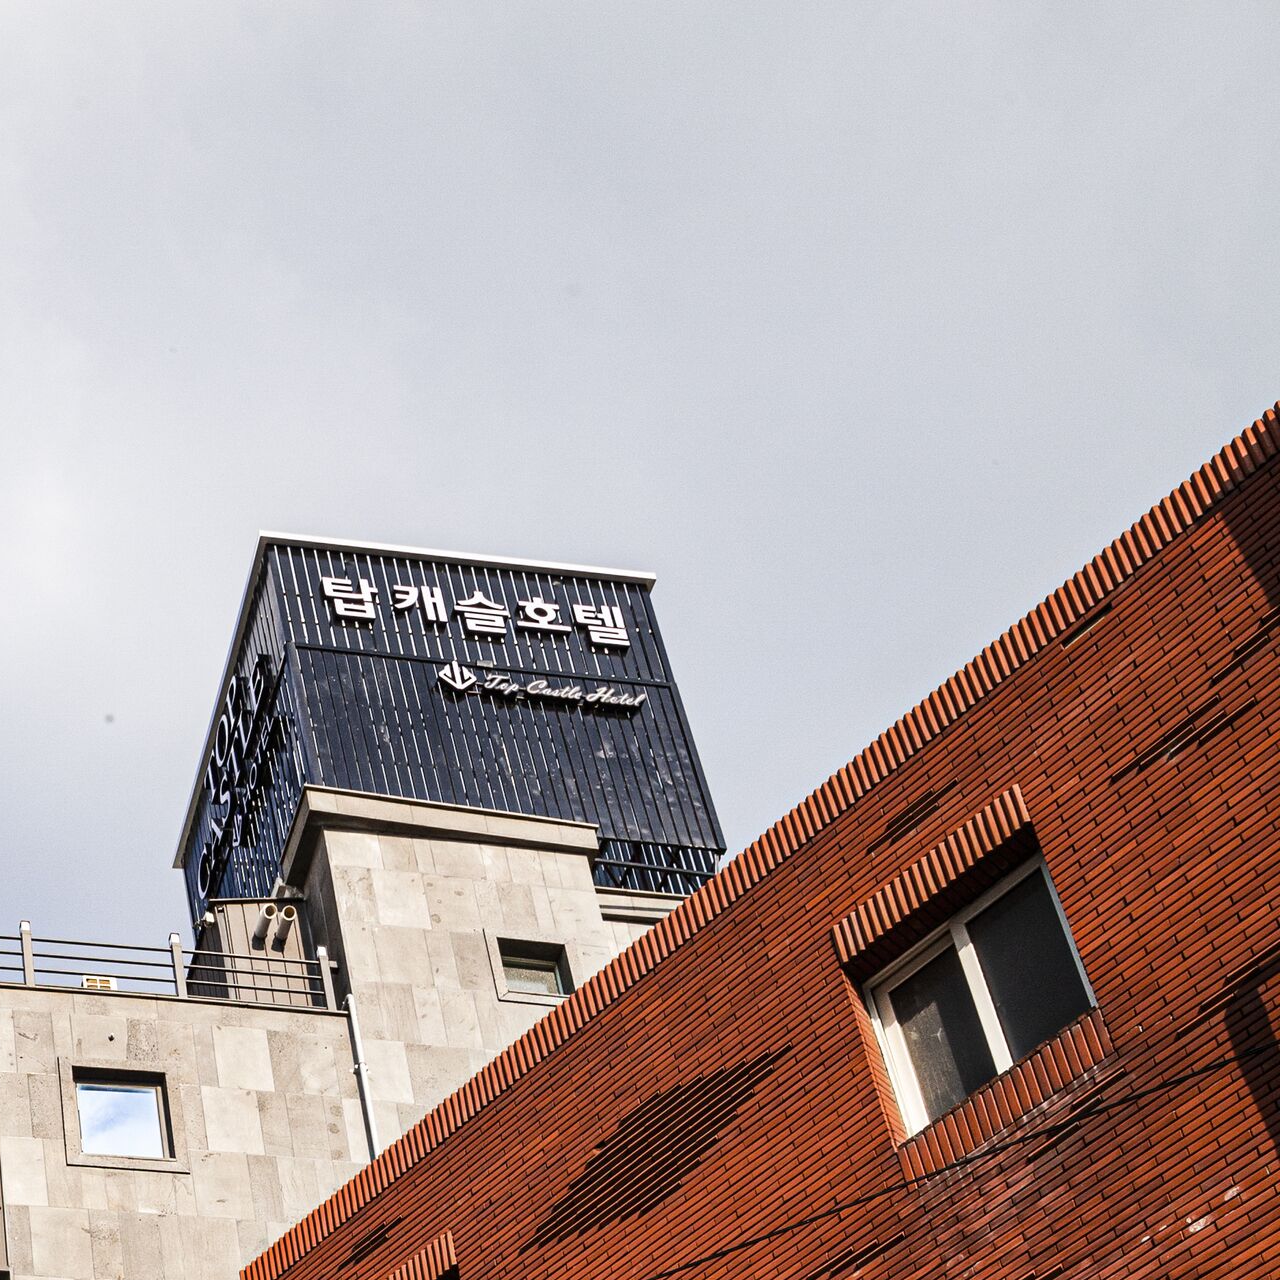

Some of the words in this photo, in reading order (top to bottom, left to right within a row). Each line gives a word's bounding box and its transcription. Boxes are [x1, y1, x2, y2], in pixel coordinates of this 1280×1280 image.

[321, 576, 630, 647] 탑캐슬호텔
[484, 672, 519, 694] Top
[527, 678, 582, 700] Castle
[586, 685, 646, 708] Hotel
